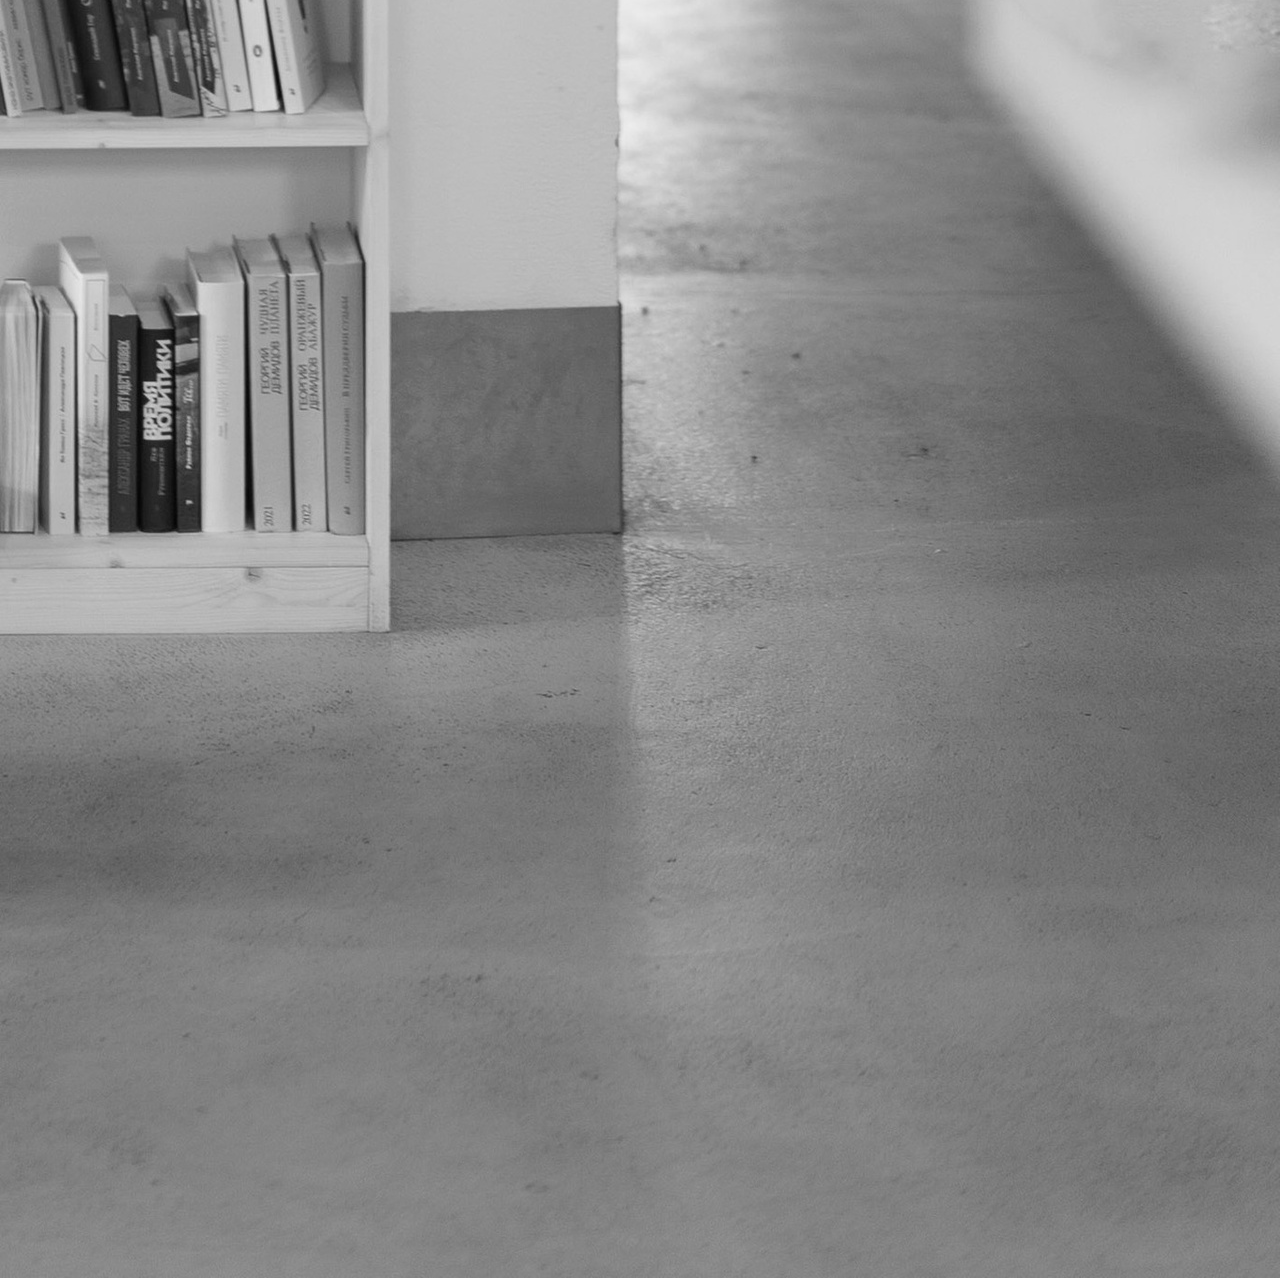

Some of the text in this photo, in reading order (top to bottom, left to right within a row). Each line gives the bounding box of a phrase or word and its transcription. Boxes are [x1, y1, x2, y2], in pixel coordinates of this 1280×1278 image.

[258, 289, 269, 335] ЧУДНАЯ
[268, 281, 280, 335] ПЛАНЕТА
[295, 280, 307, 352] ОРАНЖЕВЫЙ
[307, 303, 318, 352] АБАЖУР
[156, 340, 173, 441] ПОЛИТИКИ
[260, 348, 270, 395] ГЕОРГИЙ
[270, 341, 283, 395] ДЕМИДОВ
[298, 365, 309, 411] ГЕОРГИЙ
[308, 357, 321, 411] ДЕМИДОВ
[142, 382, 158, 441] ВРЕМЯ
[263, 506, 274, 527] 2021
[300, 504, 312, 526] 2022
